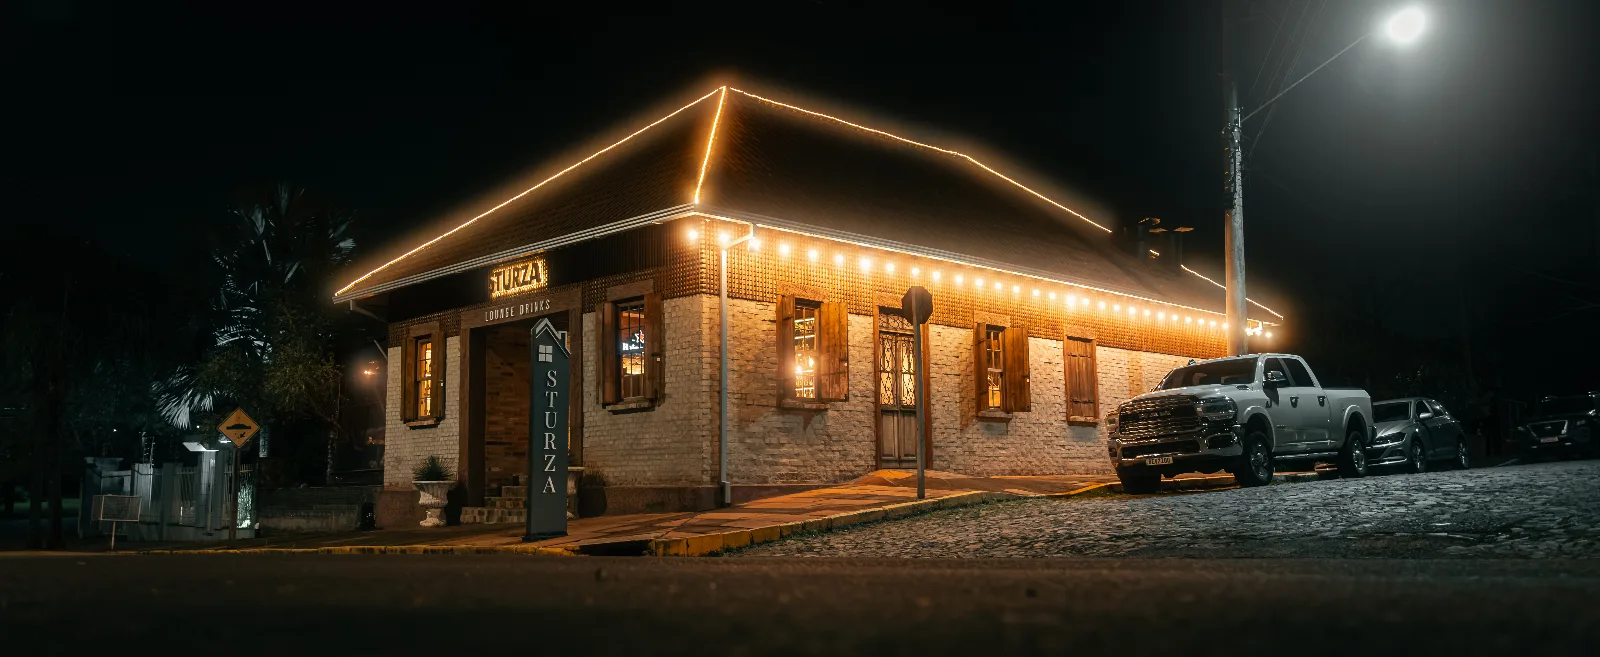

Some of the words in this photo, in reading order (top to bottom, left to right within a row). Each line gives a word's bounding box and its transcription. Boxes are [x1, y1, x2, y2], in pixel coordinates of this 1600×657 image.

[489, 262, 541, 292] STURZA
[485, 306, 515, 322] LOUNGE
[519, 299, 550, 315] DRINKS
[542, 369, 558, 493] STURZA
